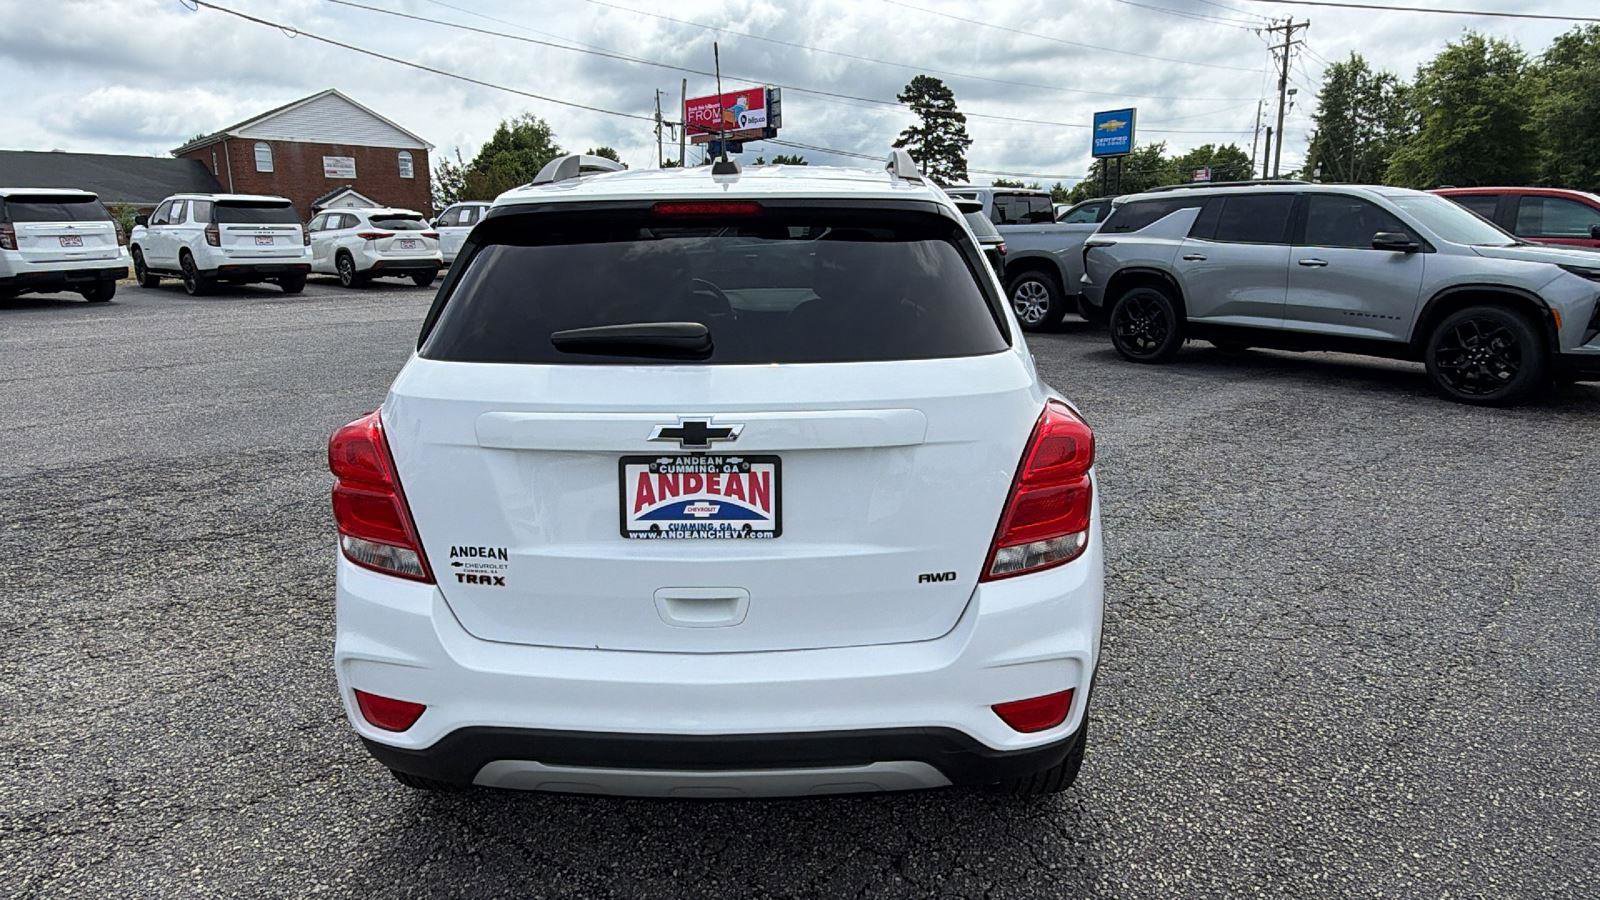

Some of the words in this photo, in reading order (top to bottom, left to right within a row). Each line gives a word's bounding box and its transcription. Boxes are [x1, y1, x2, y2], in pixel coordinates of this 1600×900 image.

[688, 107, 721, 122] FROM
[676, 456, 723, 465] ANDEAN
[659, 465, 720, 474] CUMMING,
[723, 465, 739, 473] GA
[634, 471, 771, 514] ANDEAN
[629, 530, 774, 540] www.ANDEANCHEVY.com
[450, 546, 508, 561] ANDEAN
[464, 562, 509, 570] CHEVROLET
[455, 573, 506, 587] TRAX
[918, 571, 956, 584] AWD
